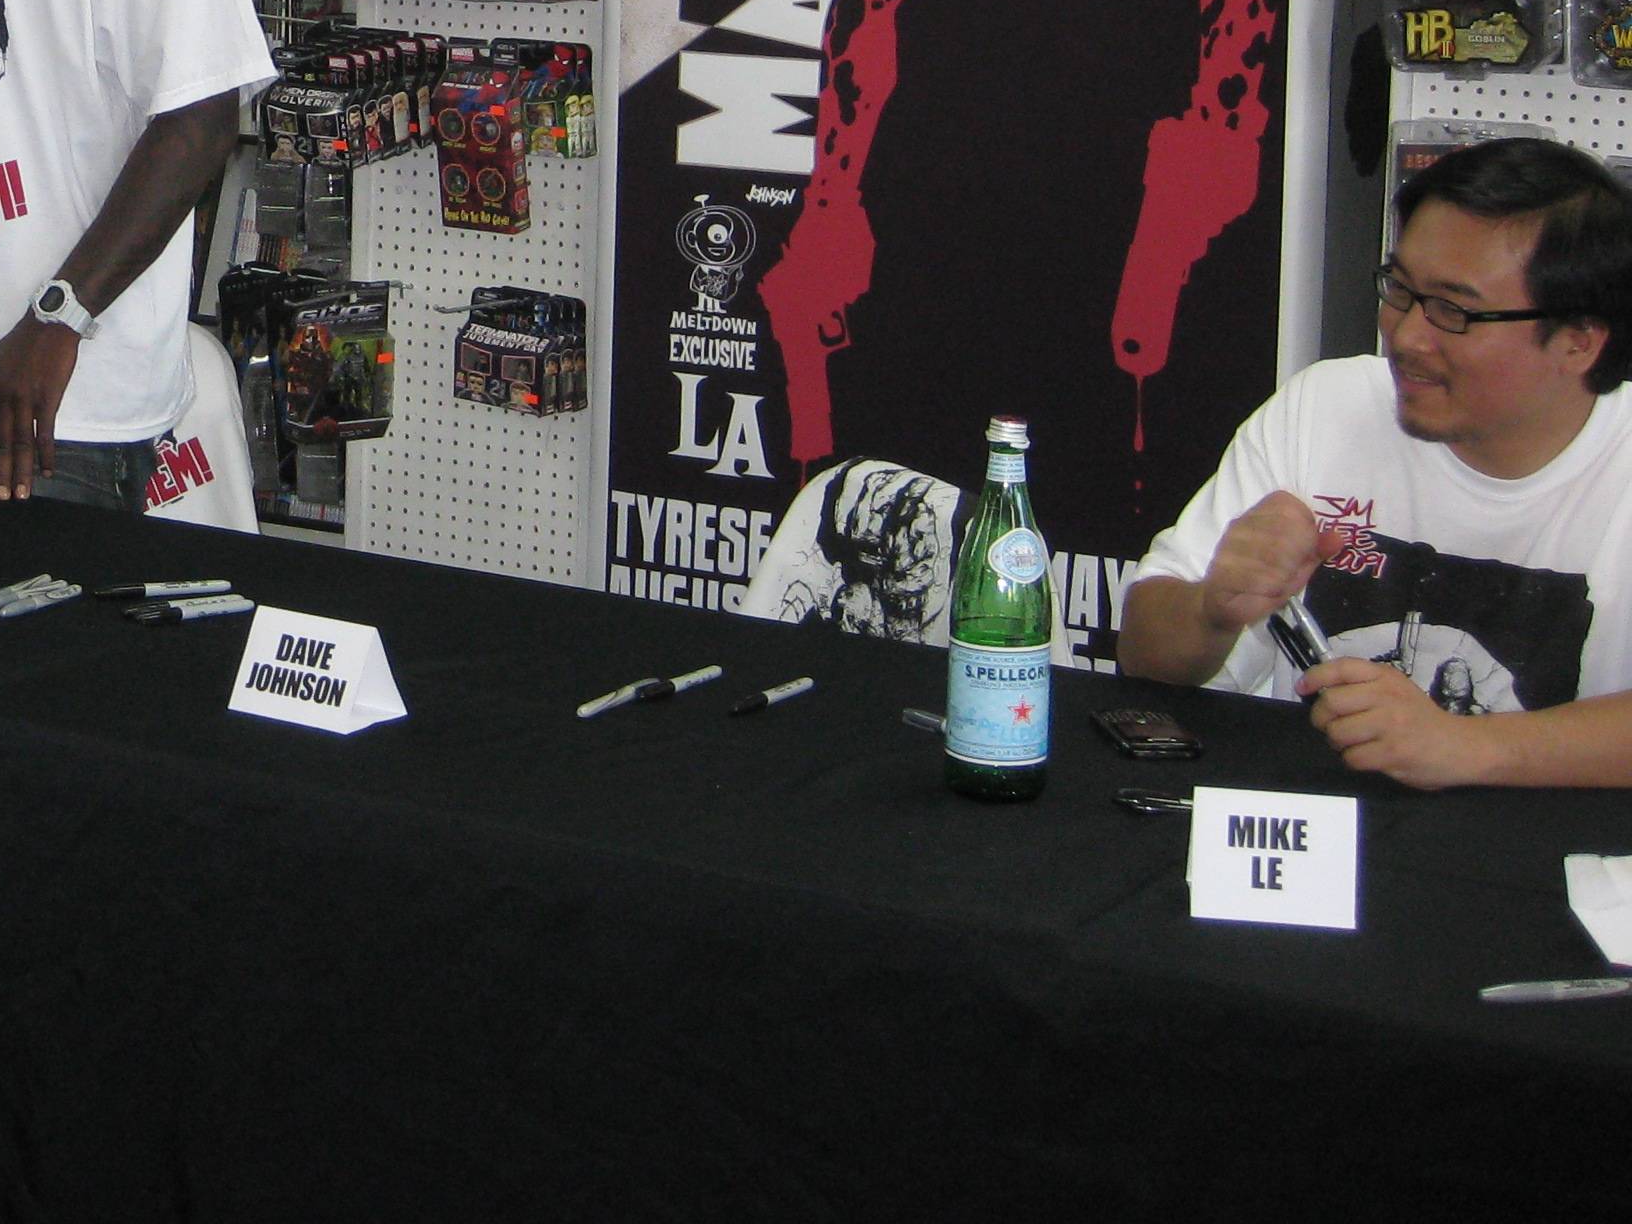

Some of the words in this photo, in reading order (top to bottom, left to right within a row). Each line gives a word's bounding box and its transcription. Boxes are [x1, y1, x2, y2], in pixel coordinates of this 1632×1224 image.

[1468, 35, 1505, 44] GOBLIN
[745, 184, 796, 207] JOHNSON
[670, 311, 757, 335] MELTDOWN
[669, 334, 756, 371] EXCLUSIVE
[668, 371, 775, 479] LA
[611, 490, 772, 577] TYRESE
[274, 633, 336, 671] DAVE
[244, 661, 348, 709] JOHNSON
[1227, 815, 1309, 853] MIKE
[1250, 856, 1284, 891] LE
